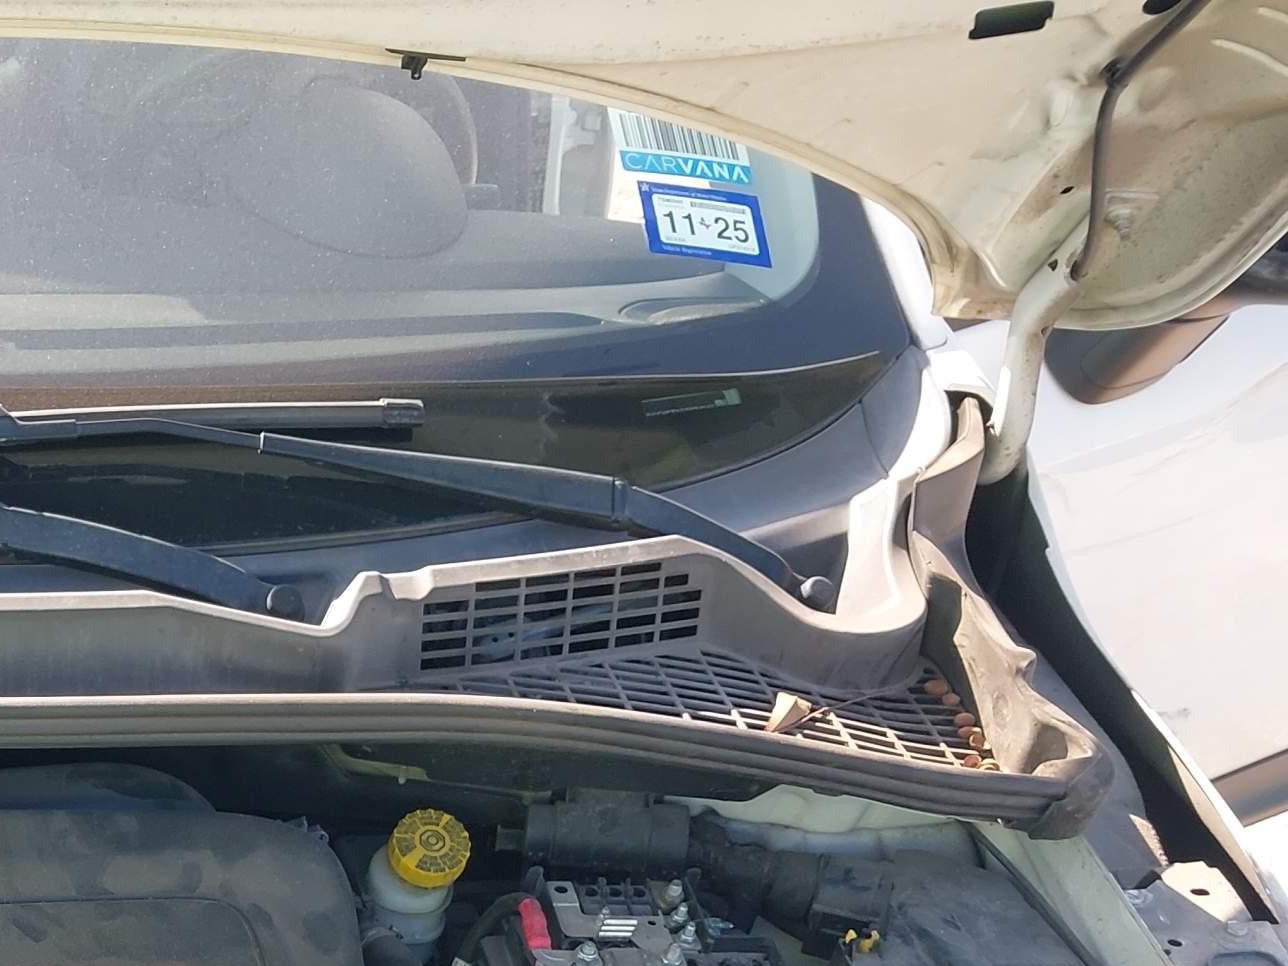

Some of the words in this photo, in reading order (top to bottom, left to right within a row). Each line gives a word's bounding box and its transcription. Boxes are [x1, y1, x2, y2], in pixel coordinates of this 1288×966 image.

[625, 153, 749, 183] CARVANA
[663, 210, 696, 236] 11
[714, 216, 750, 244] 25
